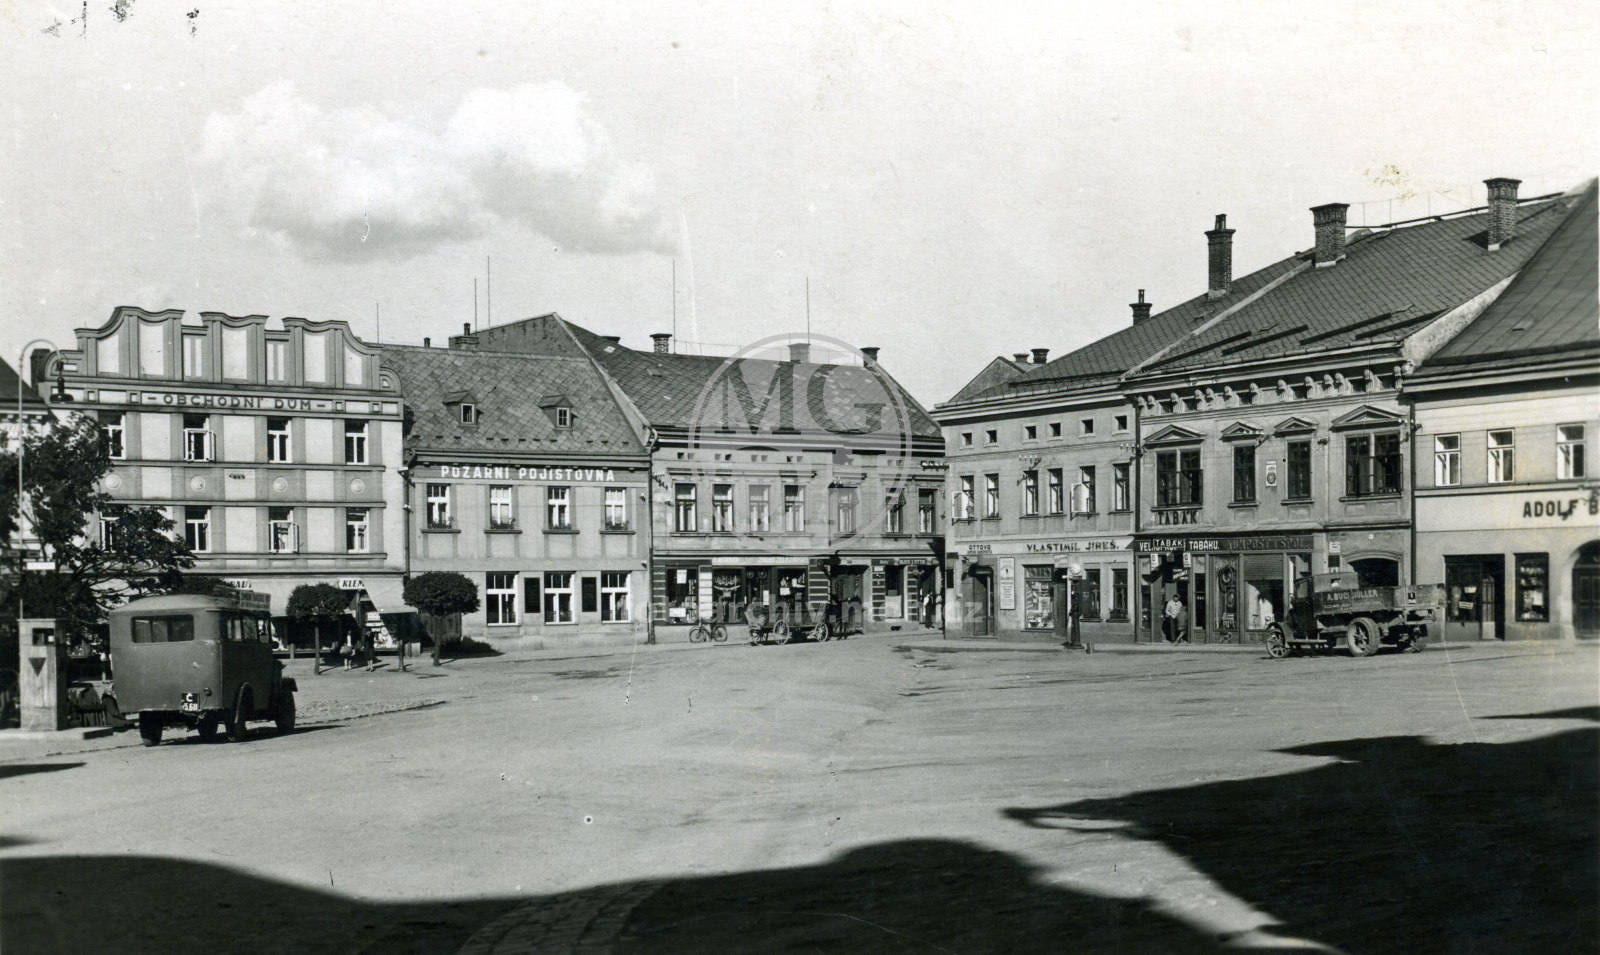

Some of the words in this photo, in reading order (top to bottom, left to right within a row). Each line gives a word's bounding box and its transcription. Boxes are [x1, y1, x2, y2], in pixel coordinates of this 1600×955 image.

[163, 393, 264, 408] OBCHODNÍ
[1523, 499, 1578, 518] ADOLF
[1026, 542, 1081, 552] VLASTIMIL
